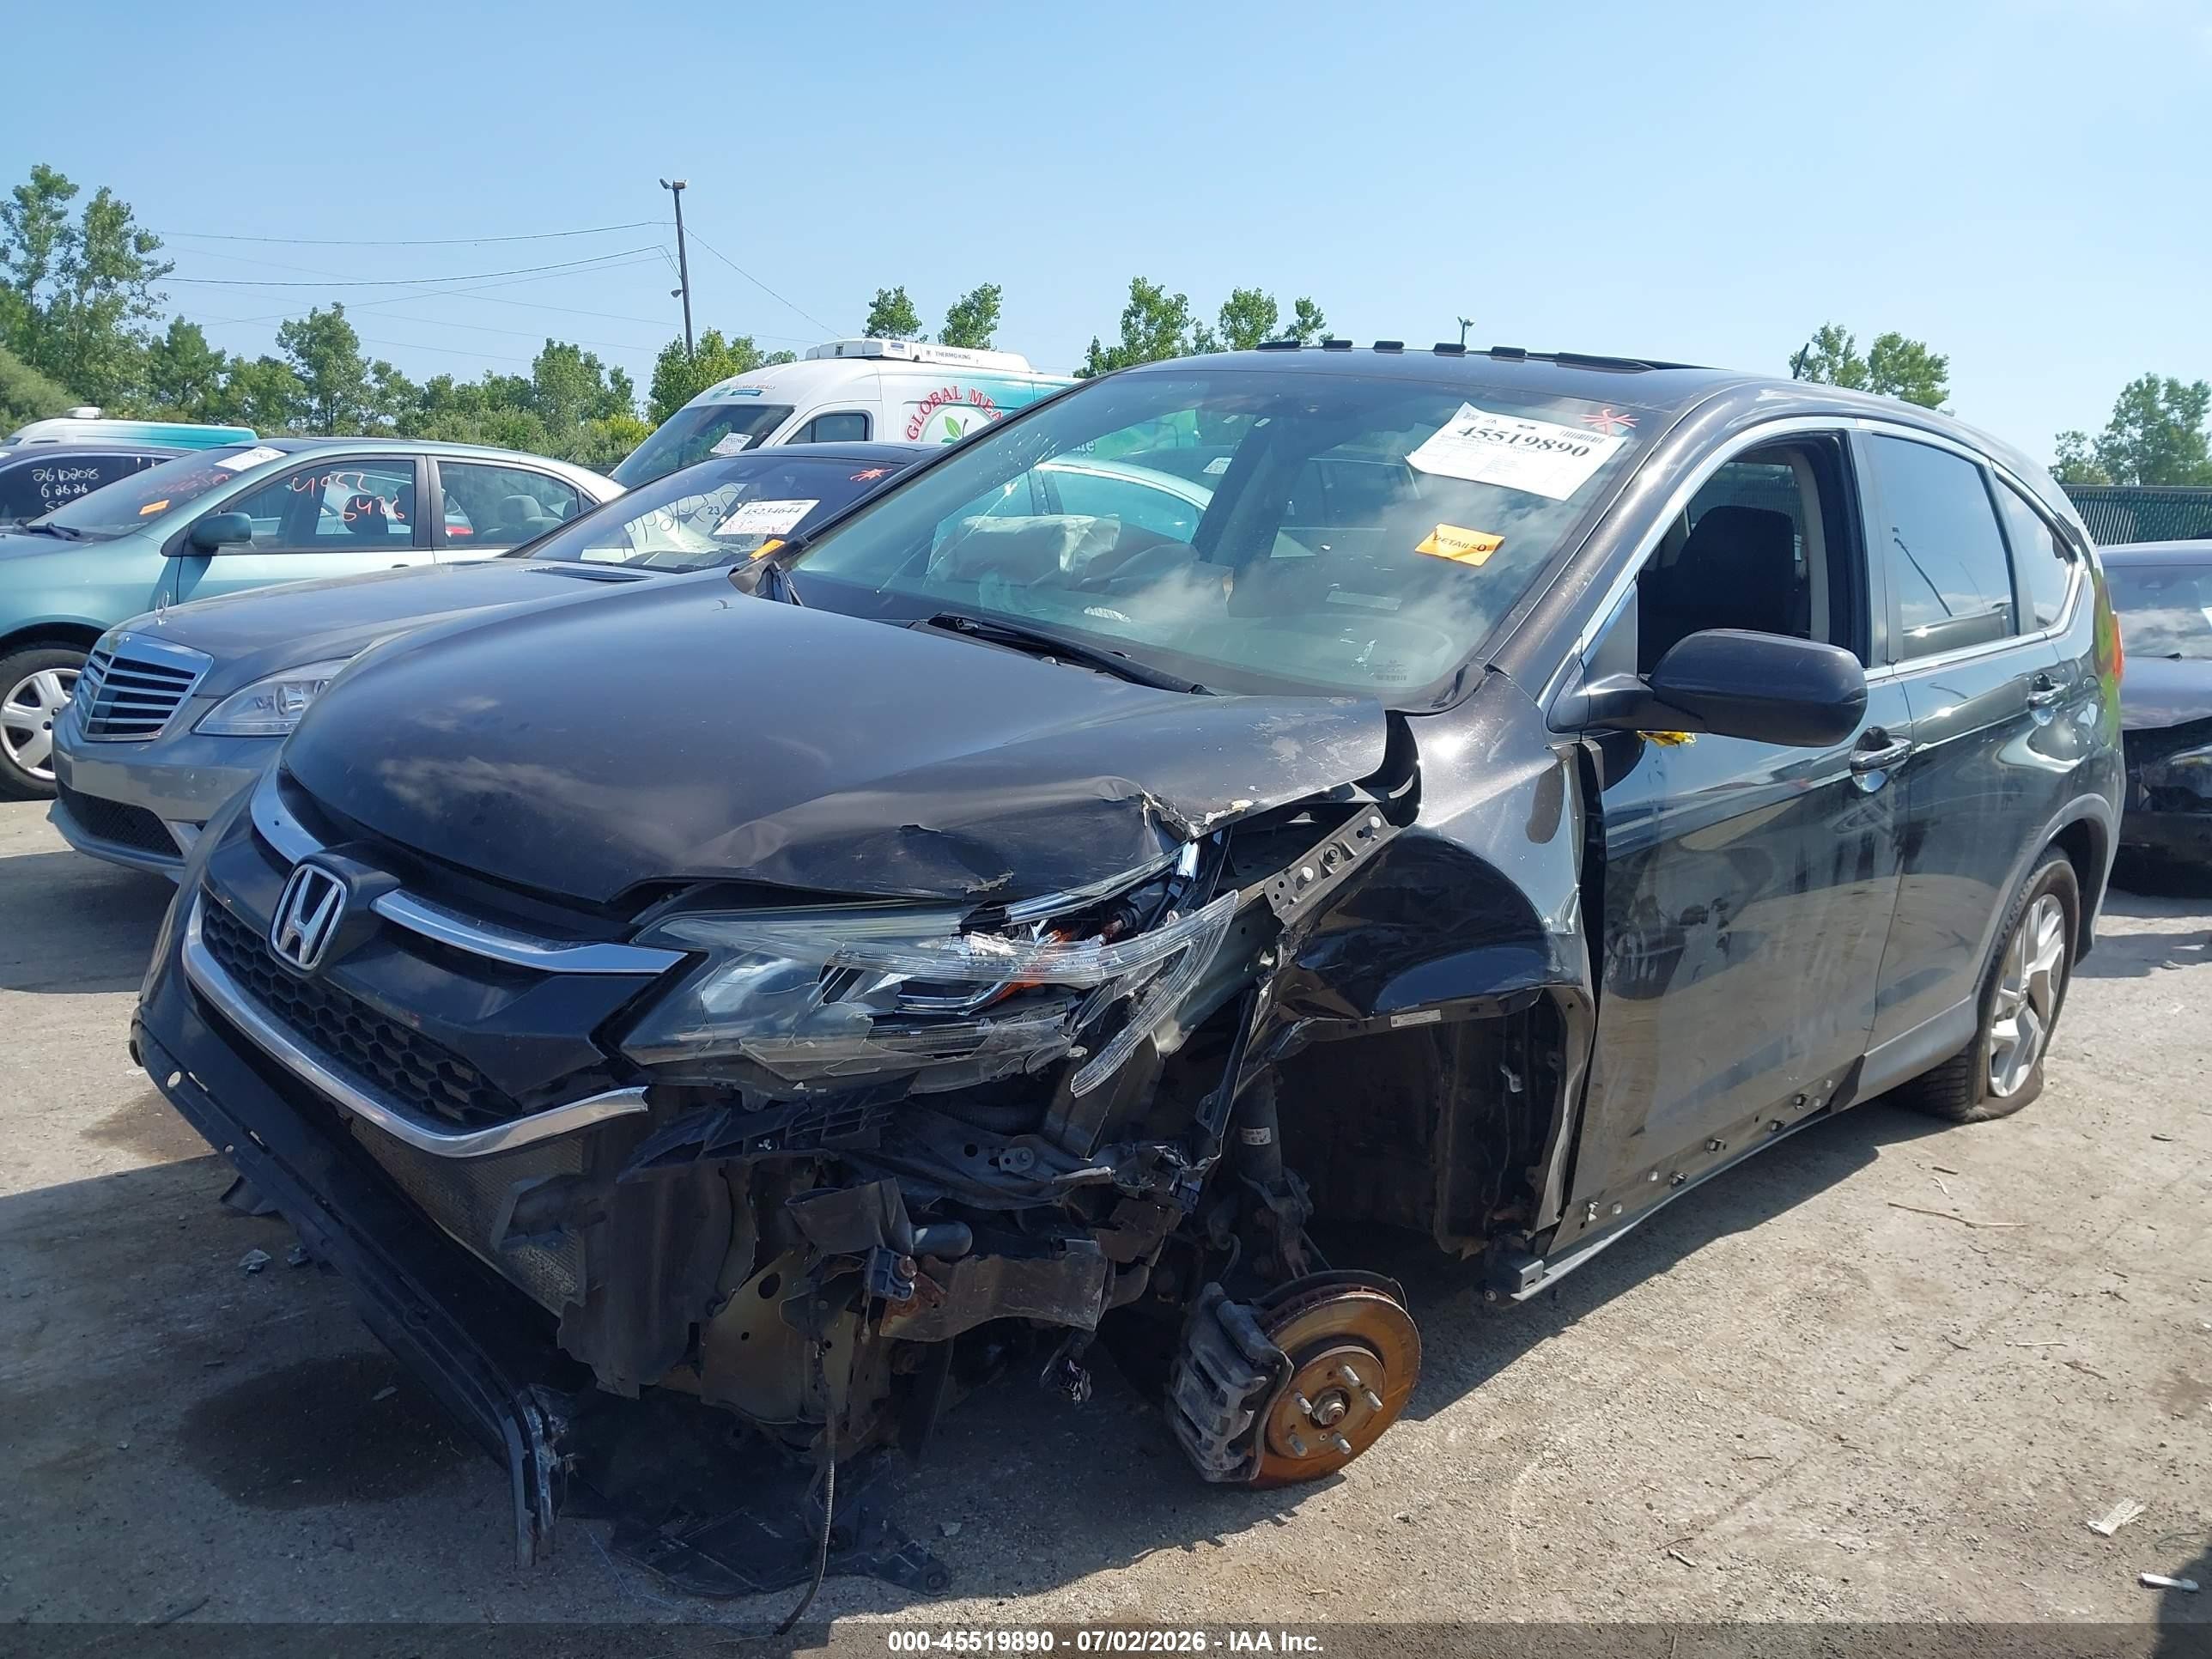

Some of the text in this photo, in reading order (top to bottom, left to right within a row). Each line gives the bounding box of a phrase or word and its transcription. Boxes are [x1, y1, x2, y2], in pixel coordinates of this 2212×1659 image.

[935, 350, 957, 359] THERMO
[906, 386, 963, 441] GLOBAL
[1457, 425, 1591, 458] 45519890
[708, 506, 720, 515] 23
